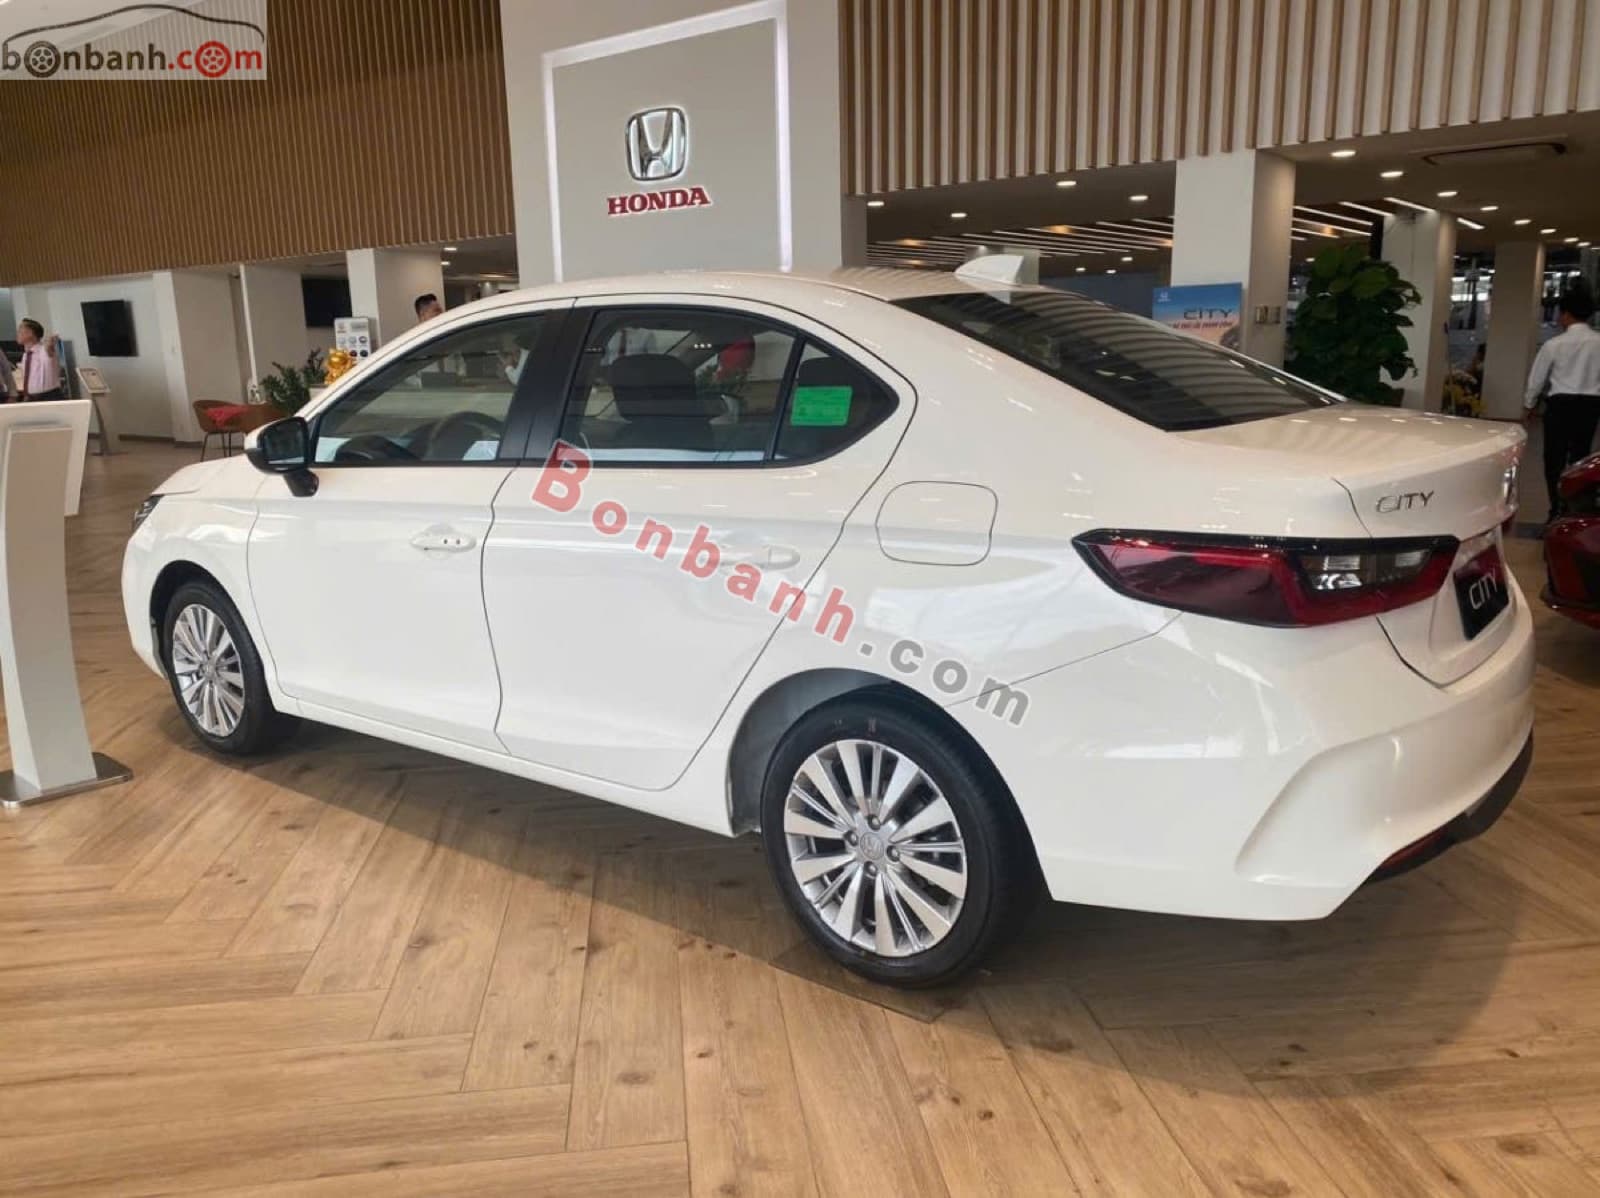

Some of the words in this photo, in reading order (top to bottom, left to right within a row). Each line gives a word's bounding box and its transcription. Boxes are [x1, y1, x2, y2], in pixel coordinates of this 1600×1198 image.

[607, 187, 711, 215] HONDA
[1184, 309, 1232, 320] CITY
[1376, 491, 1434, 513] CITY
[1469, 569, 1497, 610] CITY
